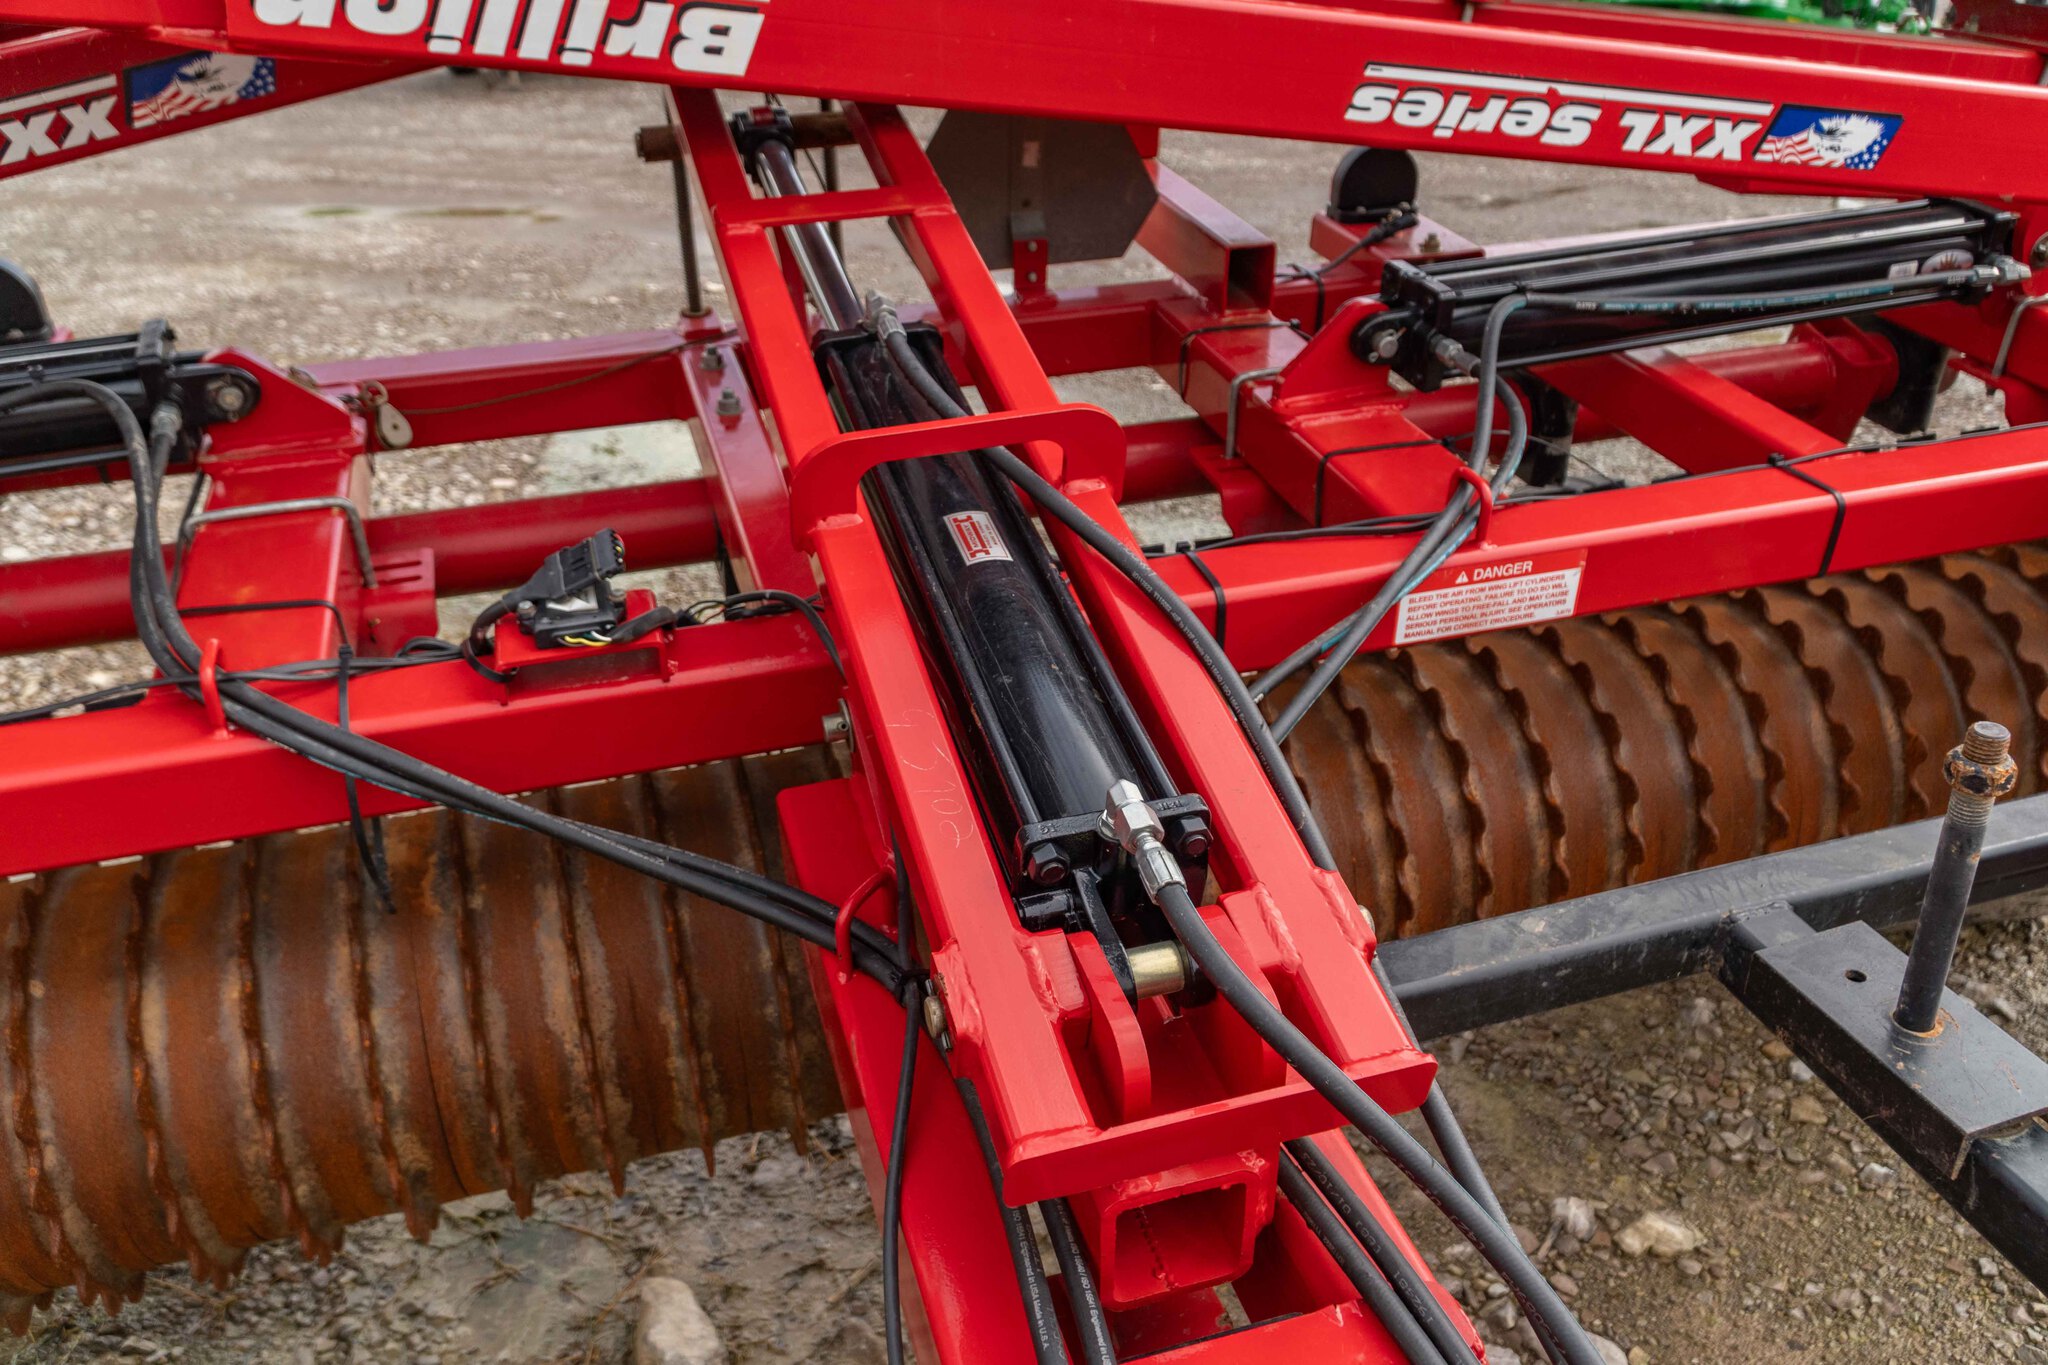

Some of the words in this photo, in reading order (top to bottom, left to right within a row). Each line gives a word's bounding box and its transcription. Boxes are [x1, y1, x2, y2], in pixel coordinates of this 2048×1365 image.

[1345, 83, 1602, 147] Series
[1620, 110, 1763, 162] XXL
[1473, 560, 1533, 581] DANGER
[1407, 604, 1437, 613] BEFORE
[1484, 591, 1514, 601] FAILURE
[1551, 581, 1568, 589] WILL
[1408, 596, 1433, 605] BLEED
[1436, 593, 1449, 601] THE
[1451, 591, 1464, 599] AIR
[1465, 586, 1487, 596] FROM
[1488, 583, 1507, 592] WING
[1508, 580, 1523, 588] LIFT
[1525, 574, 1566, 586] CYLINDERS
[1405, 620, 1437, 630] SERIOUS
[1439, 614, 1477, 625] PERSONAL
[1507, 606, 1523, 614] SEE
[1524, 598, 1567, 611] OPERATORS
[1406, 612, 1433, 622] ALLOW
[1435, 608, 1459, 618] WINGS
[1512, 596, 1527, 604] AND
[1528, 593, 1544, 602] MAY
[1545, 590, 1569, 599] CAUSE
[1404, 629, 1434, 639] MANUAL
[1436, 626, 1452, 634] FOR
[1453, 620, 1488, 631] CORRECT
[1020, 1241, 1034, 1277] Engineered
[1029, 1283, 1040, 1300] USA
[1033, 1300, 1043, 1319] Made
[1081, 1277, 1090, 1289] ISO
[1090, 1310, 1107, 1346] Engineered
